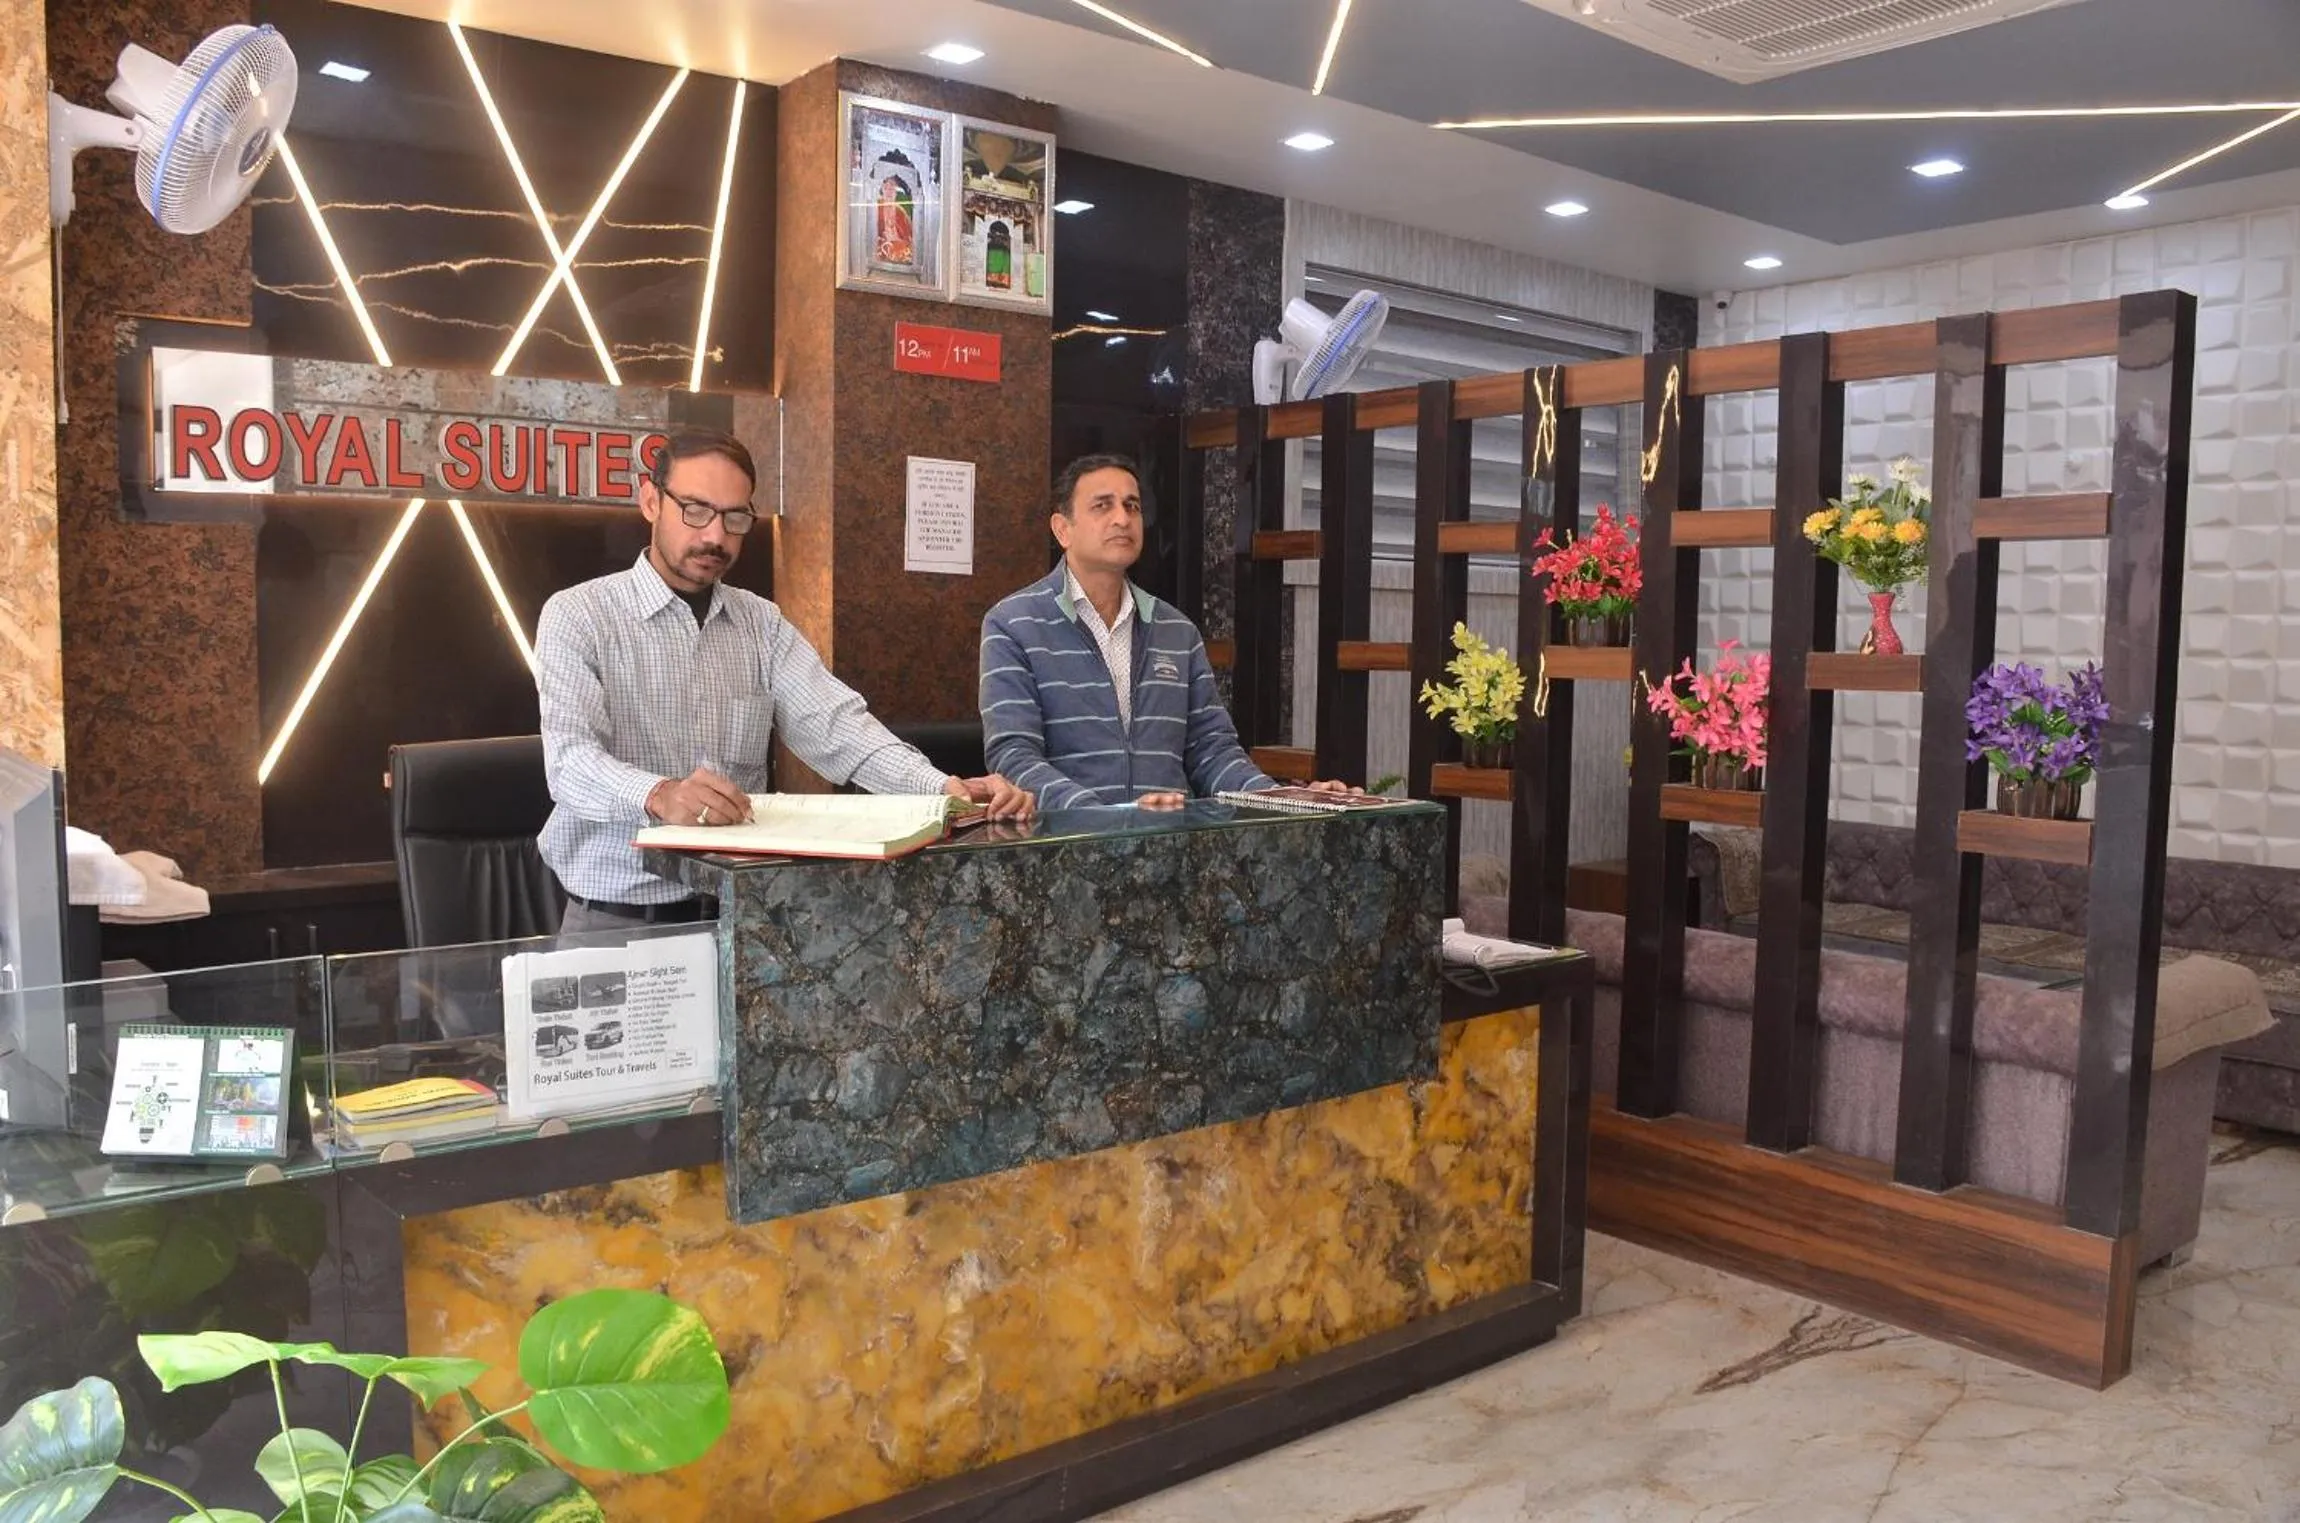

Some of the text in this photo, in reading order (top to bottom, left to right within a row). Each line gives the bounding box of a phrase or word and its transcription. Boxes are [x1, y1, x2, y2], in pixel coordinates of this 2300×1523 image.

[171, 404, 425, 489] ROYAL
[534, 1060, 657, 1086] Royal Suites Tour & Travels
